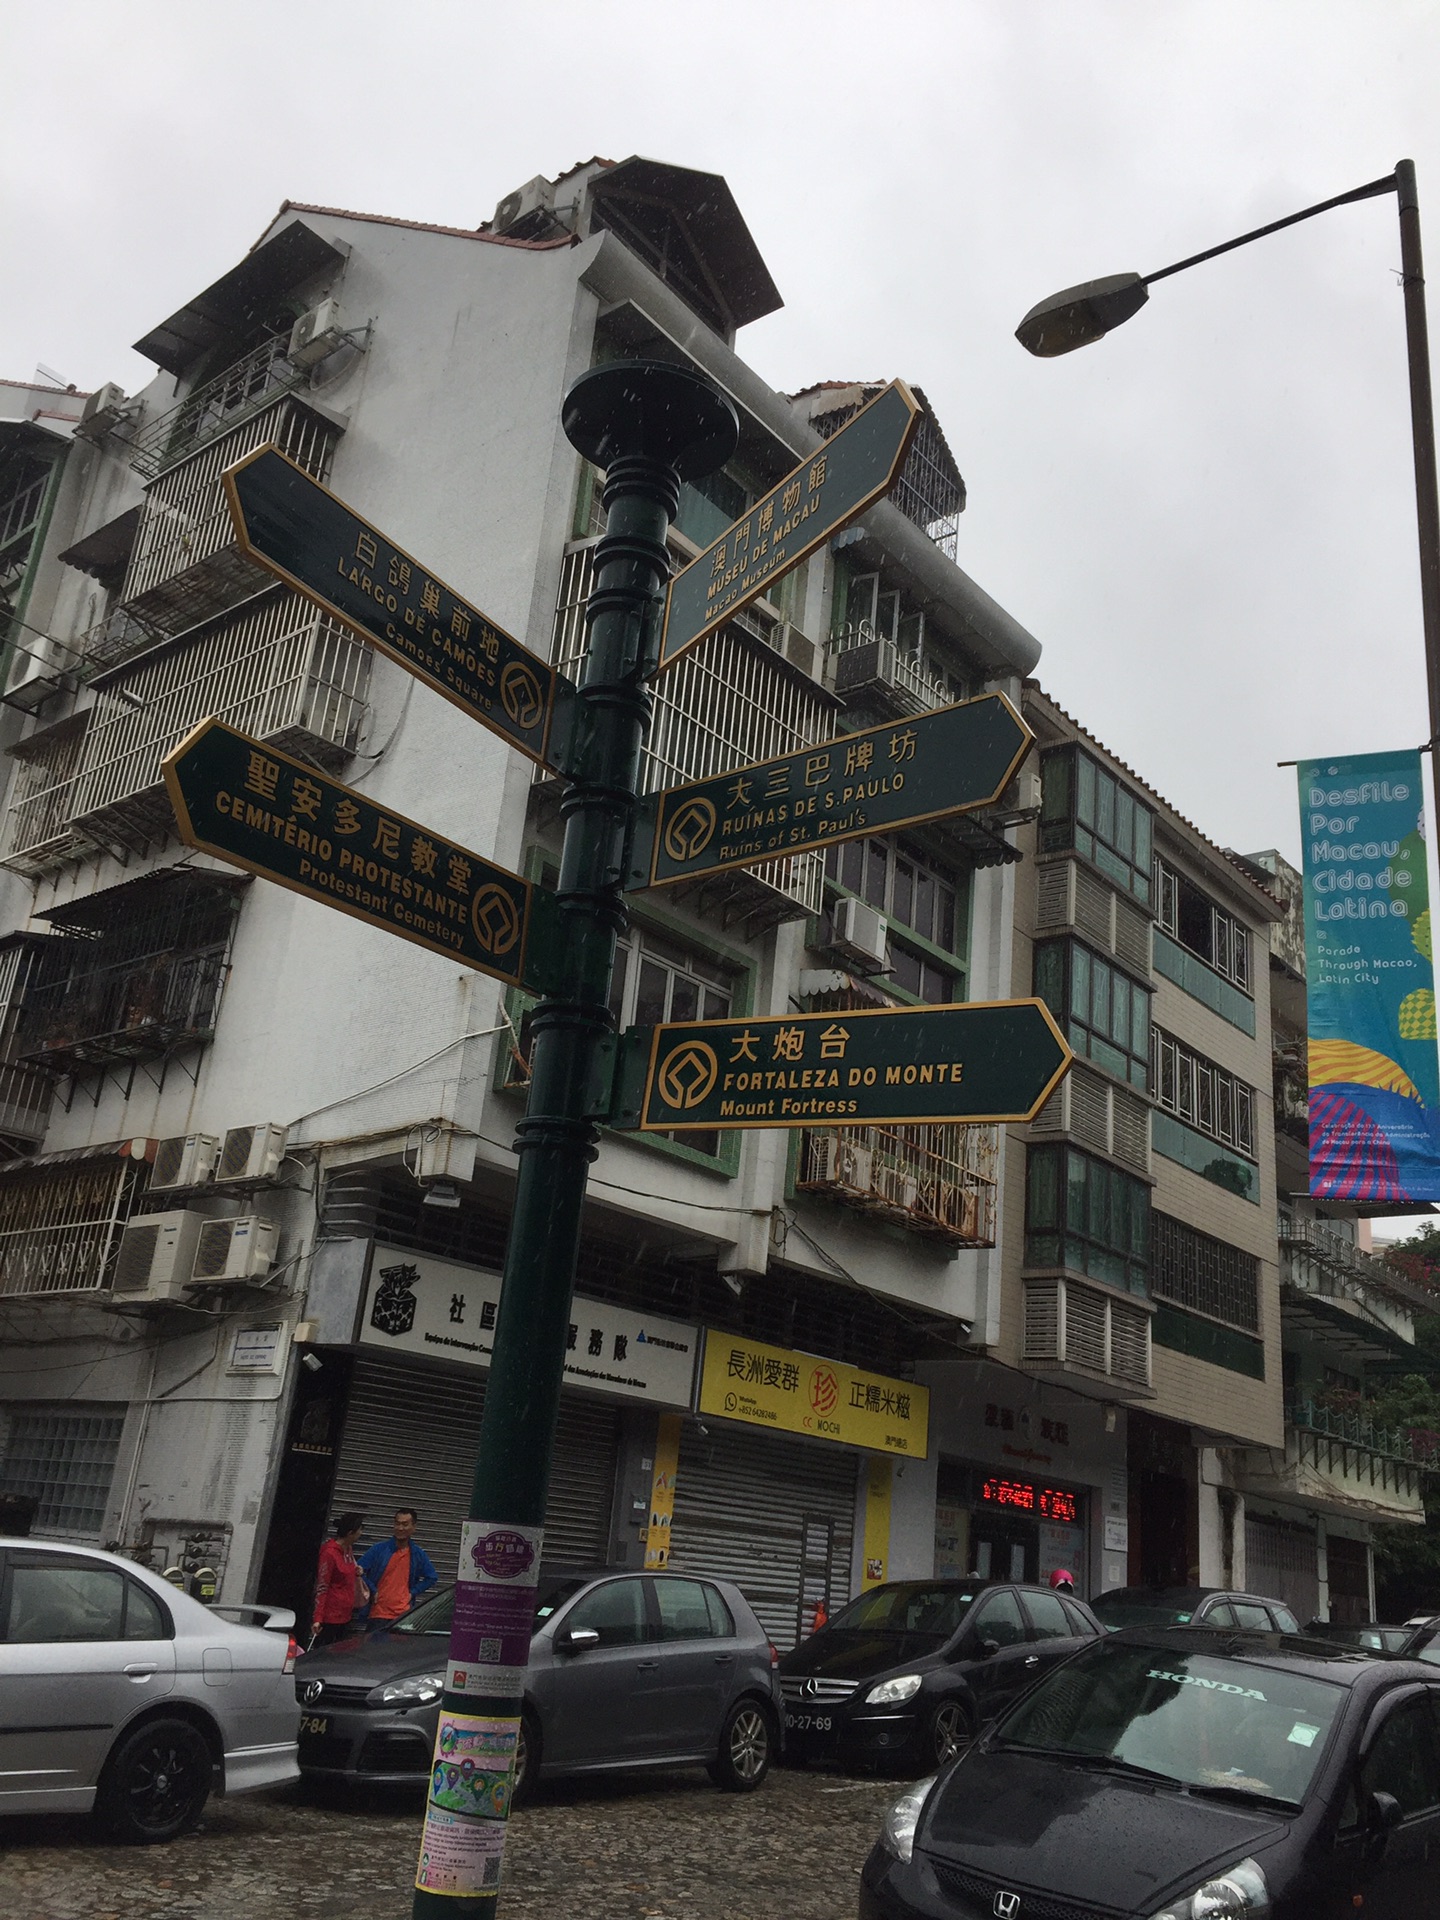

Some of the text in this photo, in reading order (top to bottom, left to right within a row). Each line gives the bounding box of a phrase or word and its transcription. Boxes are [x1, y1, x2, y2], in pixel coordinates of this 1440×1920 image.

[710, 455, 828, 579] 澳門博物館
[707, 494, 821, 600] MUSEU DE MACAU
[354, 531, 499, 664] 白鴿巢前地
[705, 549, 786, 621] Macao Museum
[337, 556, 496, 687] LARGO DE CAMÕES
[386, 621, 492, 710] Camoes Square
[725, 729, 918, 811] 大三巴牌坊
[1309, 781, 1409, 808] Desfile
[244, 750, 472, 895] 聖安多尼教堂
[719, 810, 867, 859] Ruins of St. Paul's
[722, 804, 787, 835] RUÍNAS
[794, 796, 817, 816] DE
[1310, 812, 1360, 835] Por
[216, 791, 468, 924] CEMITÉRIO PROTESTANTE
[1311, 840, 1411, 864] Macau,
[1312, 867, 1412, 893] Cidade
[299, 859, 464, 949] Protestant Cemetery
[1314, 896, 1409, 921] Latina
[1318, 945, 1361, 956] Parade
[1318, 958, 1417, 970] Through Macao,
[1319, 973, 1379, 984] Latin City
[729, 1024, 850, 1063] 大炮台
[723, 1064, 963, 1091] FORTALEZA DO MONTE
[720, 1097, 858, 1116] Mount Fortress
[727, 1350, 799, 1393] 長洲愛群
[813, 1371, 837, 1411] 珍
[817, 1420, 841, 1434] MOCHI
[1146, 1670, 1268, 1701] HONDA
